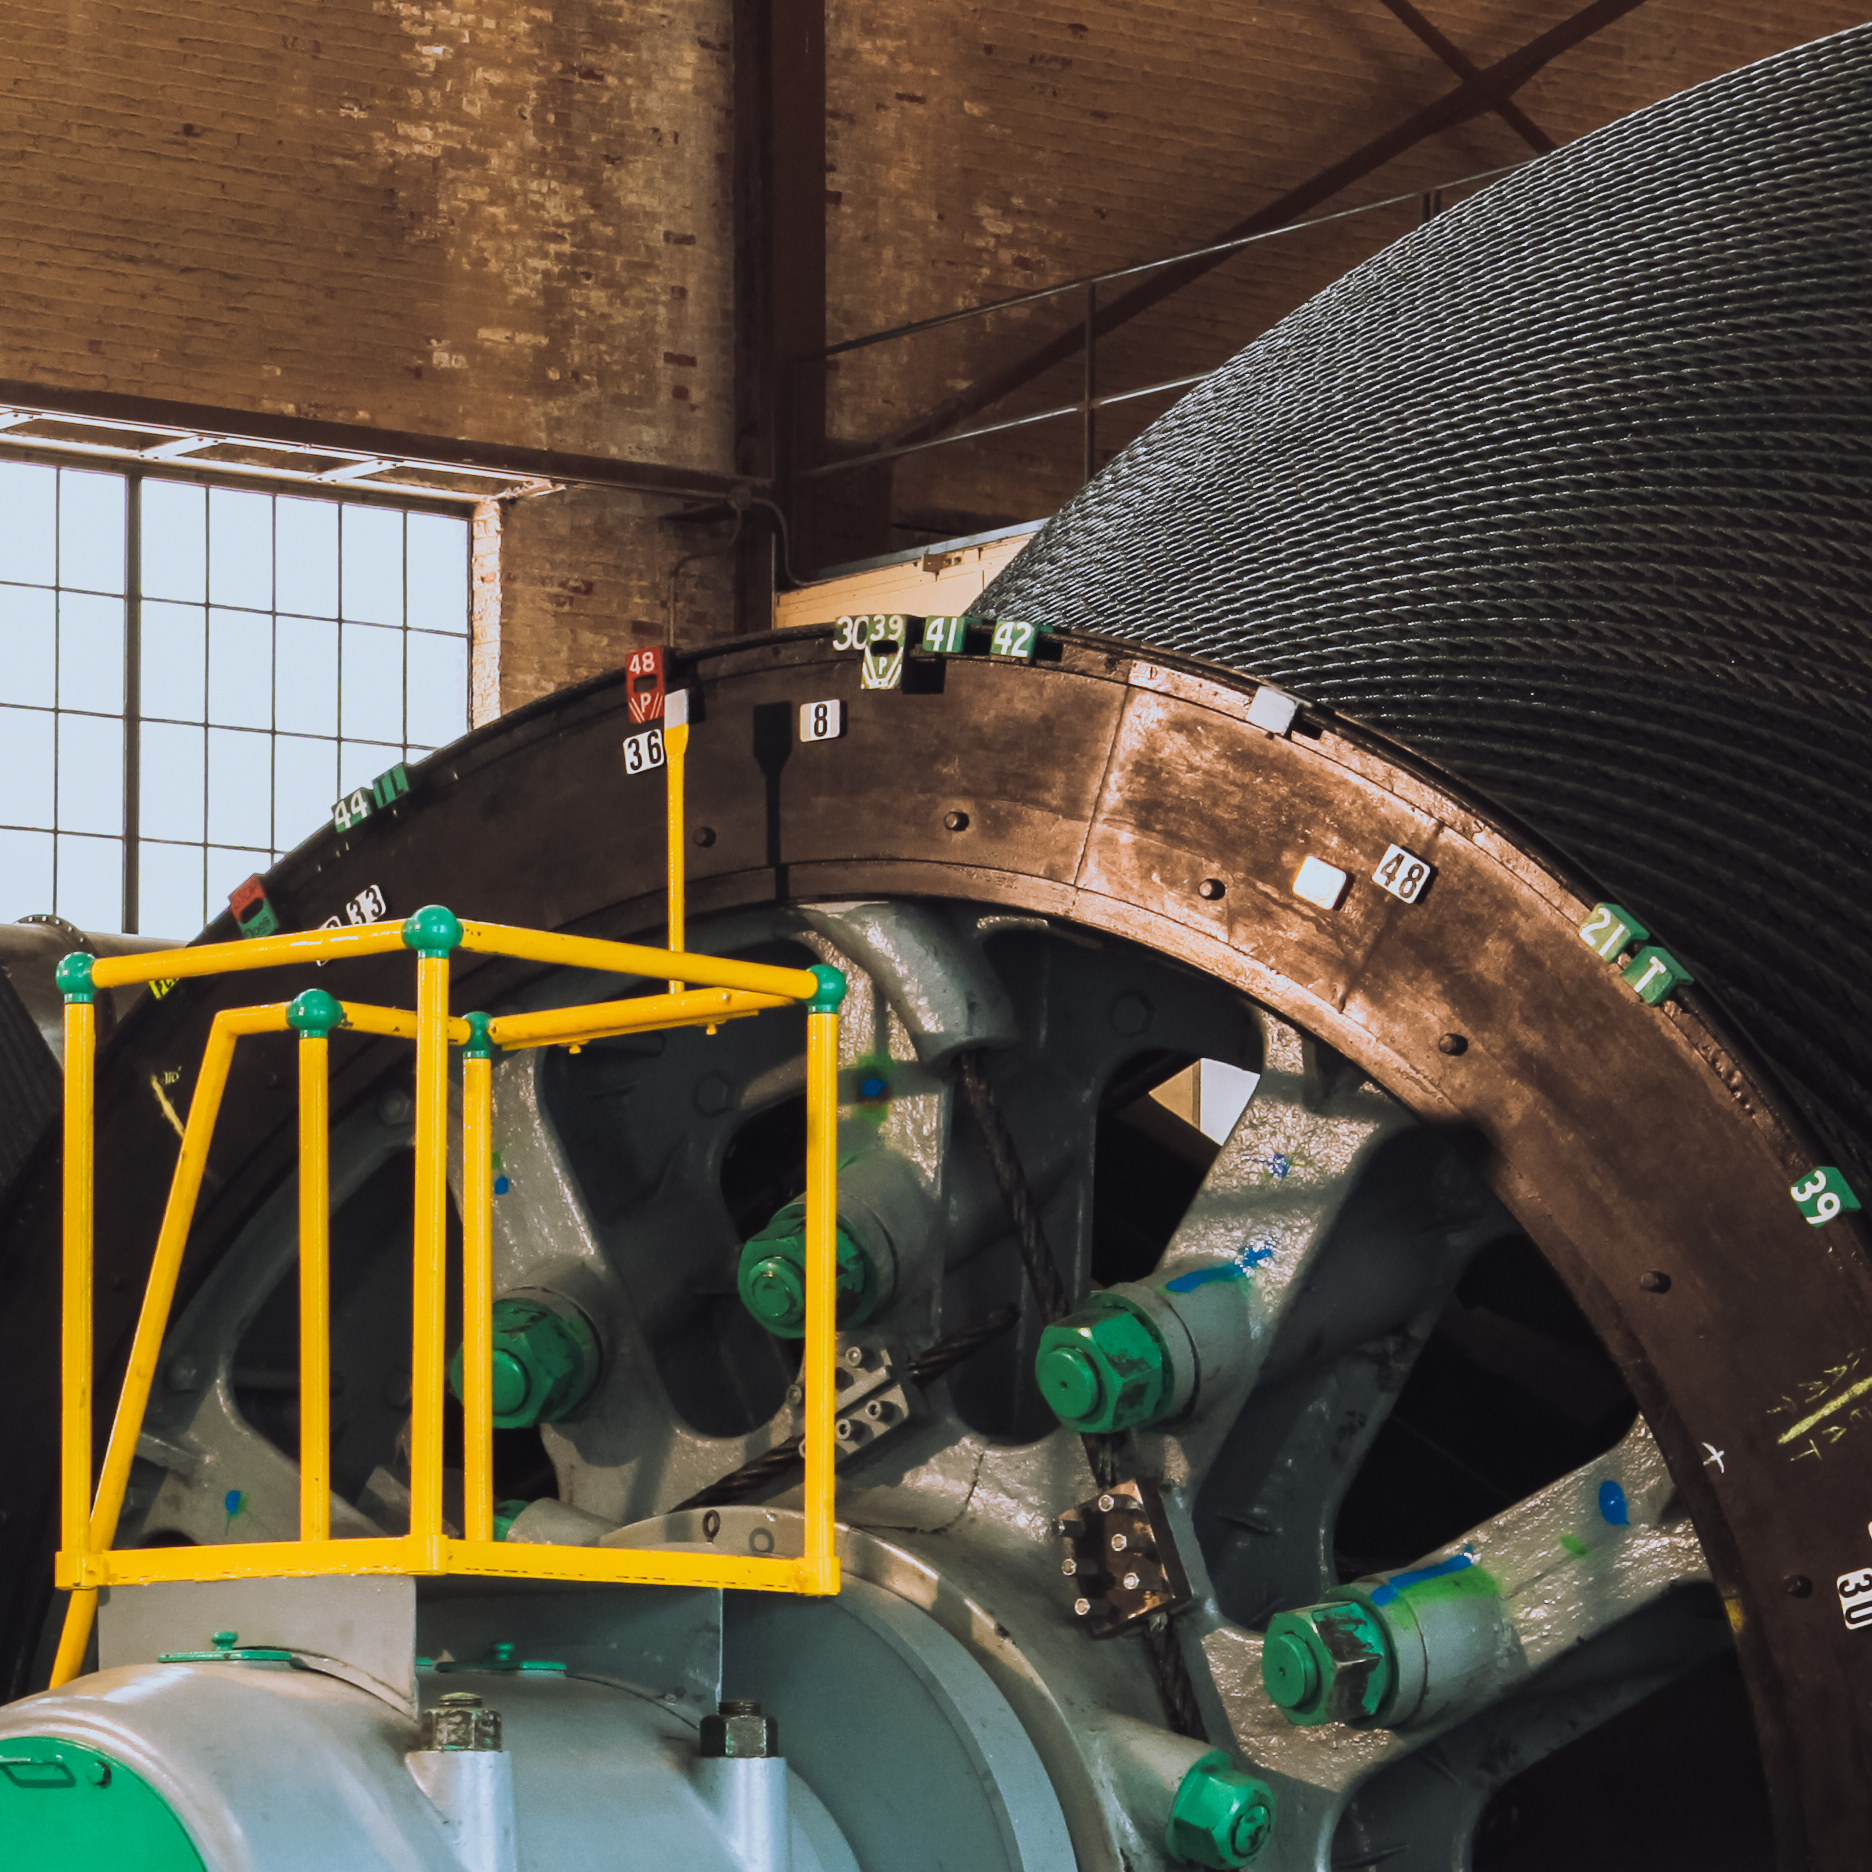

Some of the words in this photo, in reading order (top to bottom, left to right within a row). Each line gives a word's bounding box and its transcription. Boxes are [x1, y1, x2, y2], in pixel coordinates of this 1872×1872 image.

[870, 615, 904, 641] 39
[925, 616, 960, 652] 41
[995, 621, 1033, 658] 42
[628, 650, 655, 675] 48
[877, 657, 888, 674] P
[639, 692, 651, 714] P
[813, 702, 828, 738] 8
[627, 729, 663, 772] 36
[334, 789, 368, 829] 44
[1380, 853, 1425, 900] 48
[348, 887, 382, 925] 33
[1579, 907, 1626, 957] 21
[1633, 955, 1668, 994] T
[1790, 1169, 1841, 1226] 39
